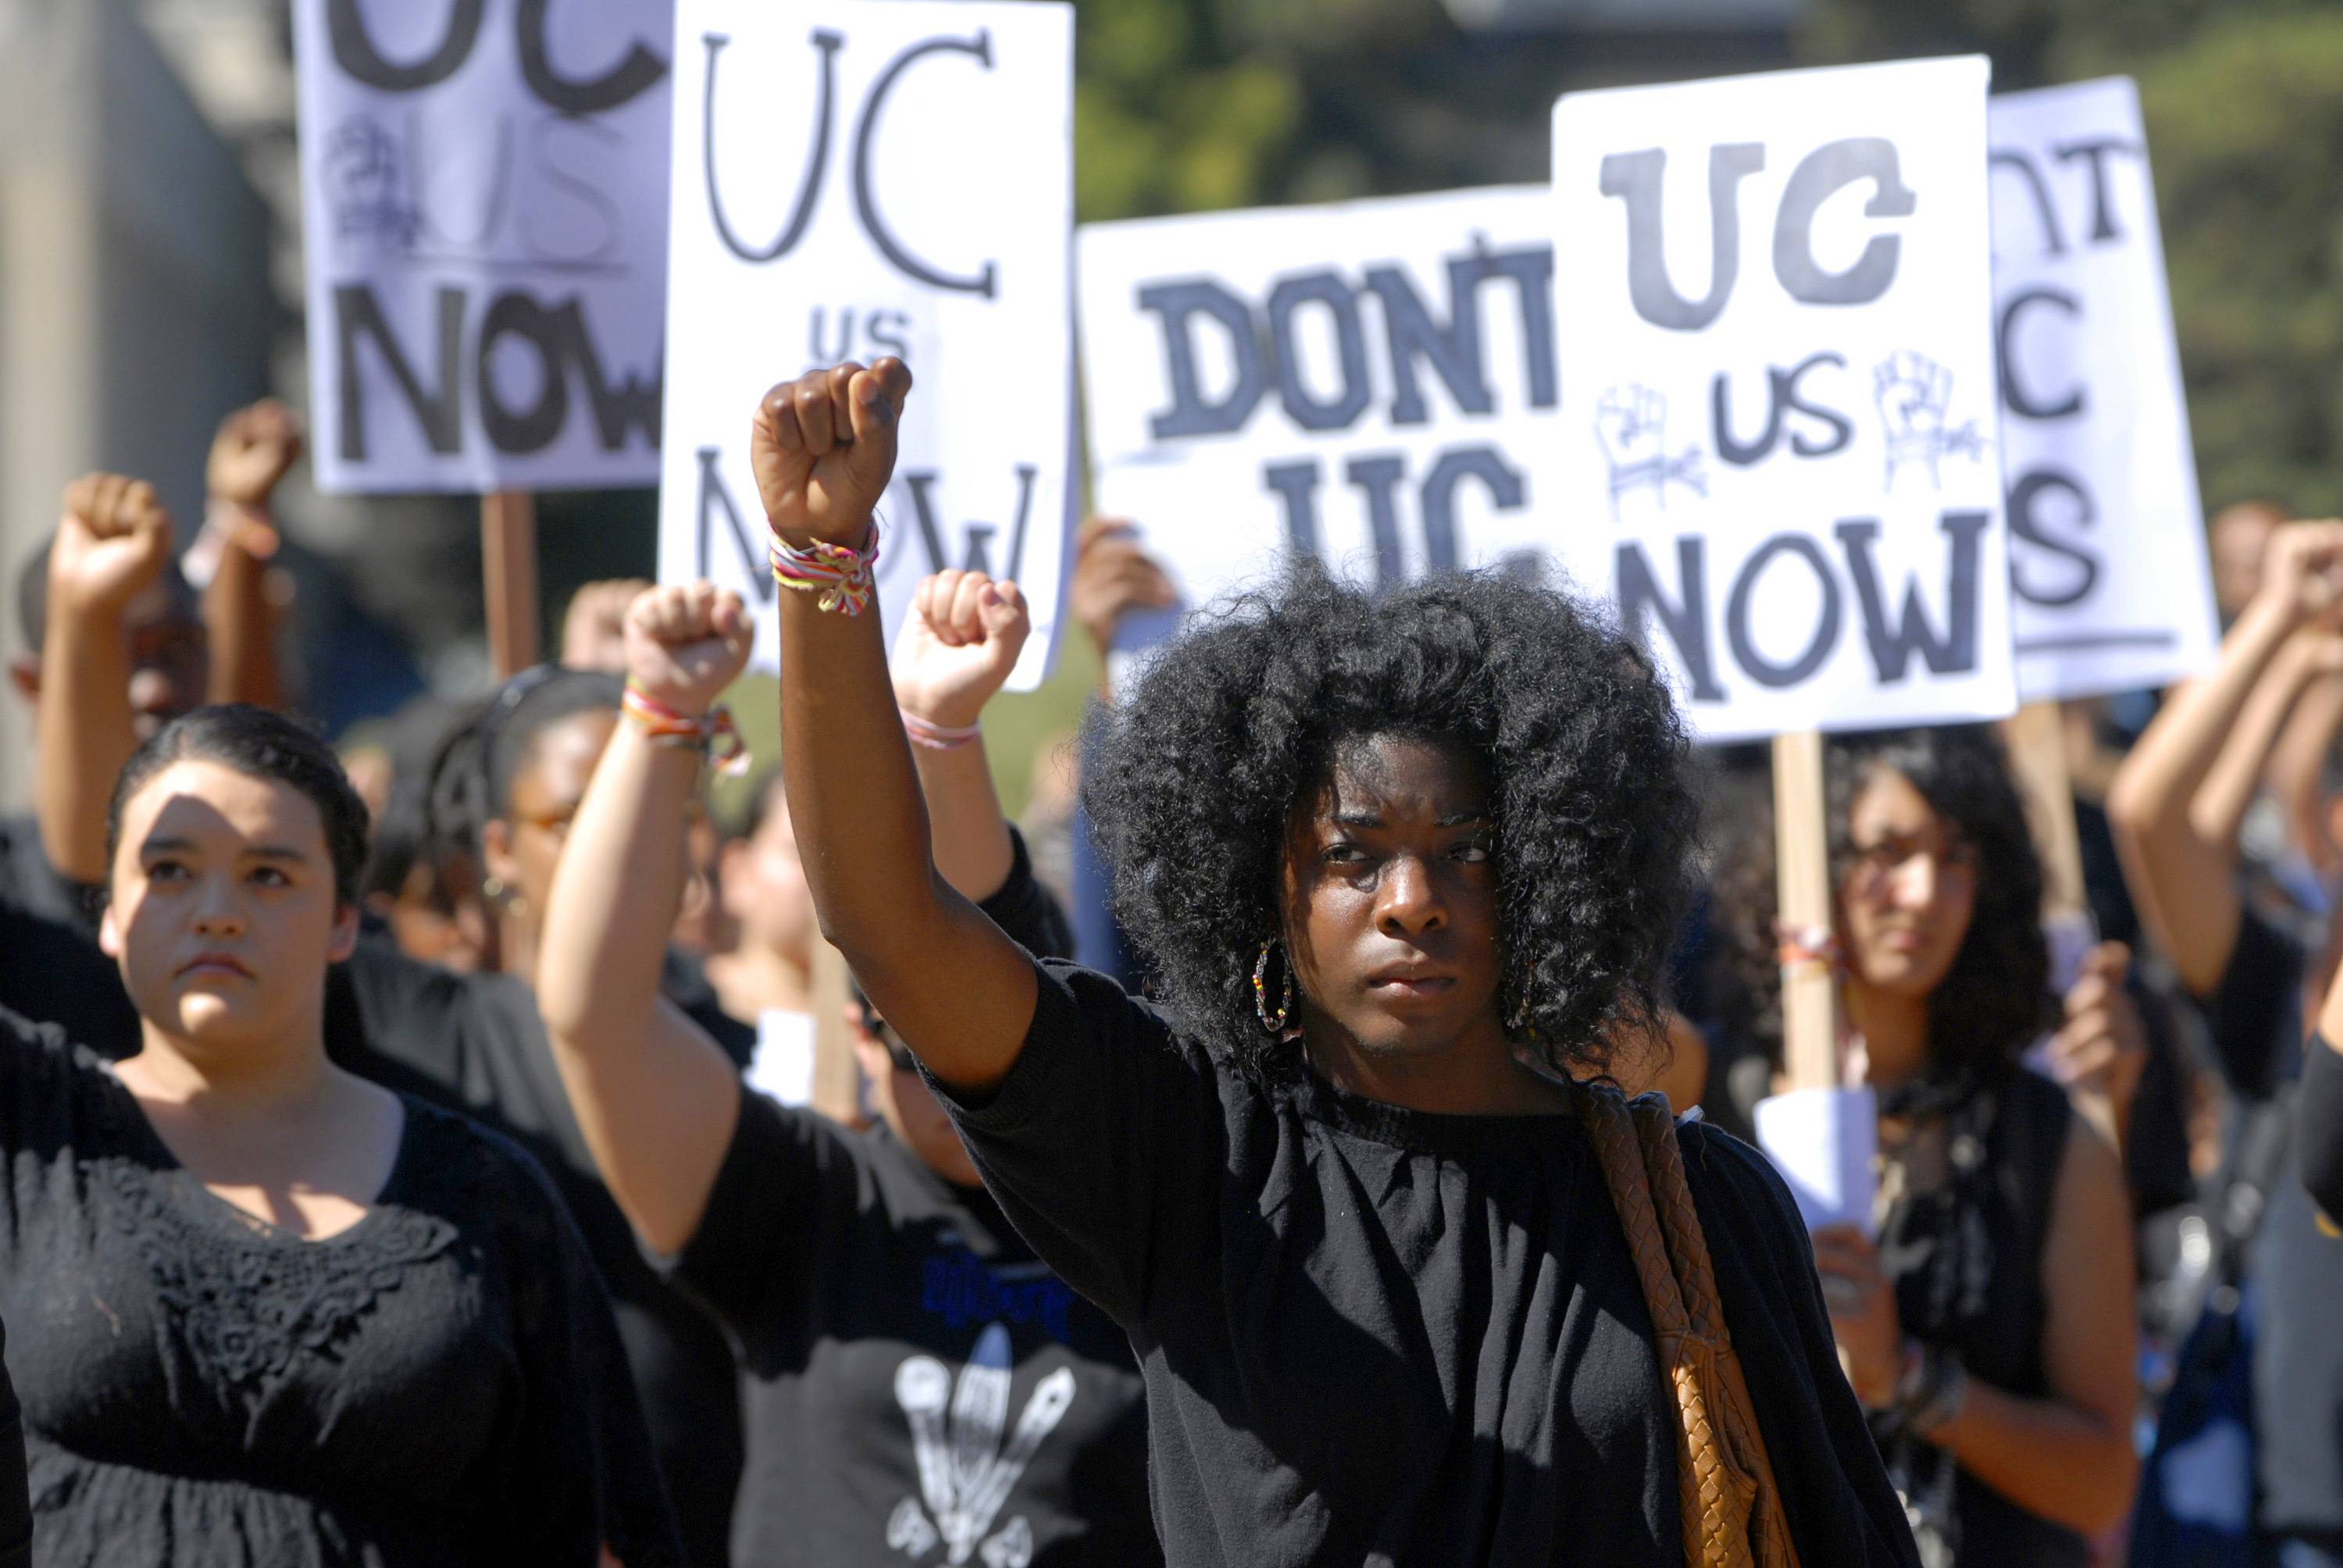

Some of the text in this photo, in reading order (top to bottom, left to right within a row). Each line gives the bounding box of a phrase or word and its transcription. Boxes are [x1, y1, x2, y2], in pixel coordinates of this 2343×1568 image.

[402, 109, 629, 272] US
[701, 28, 997, 298] UC
[1599, 137, 1917, 331] UC
[808, 309, 914, 365] US
[1714, 353, 1854, 467] US
[697, 447, 1037, 603] NW
[1617, 512, 1990, 703] NOW
